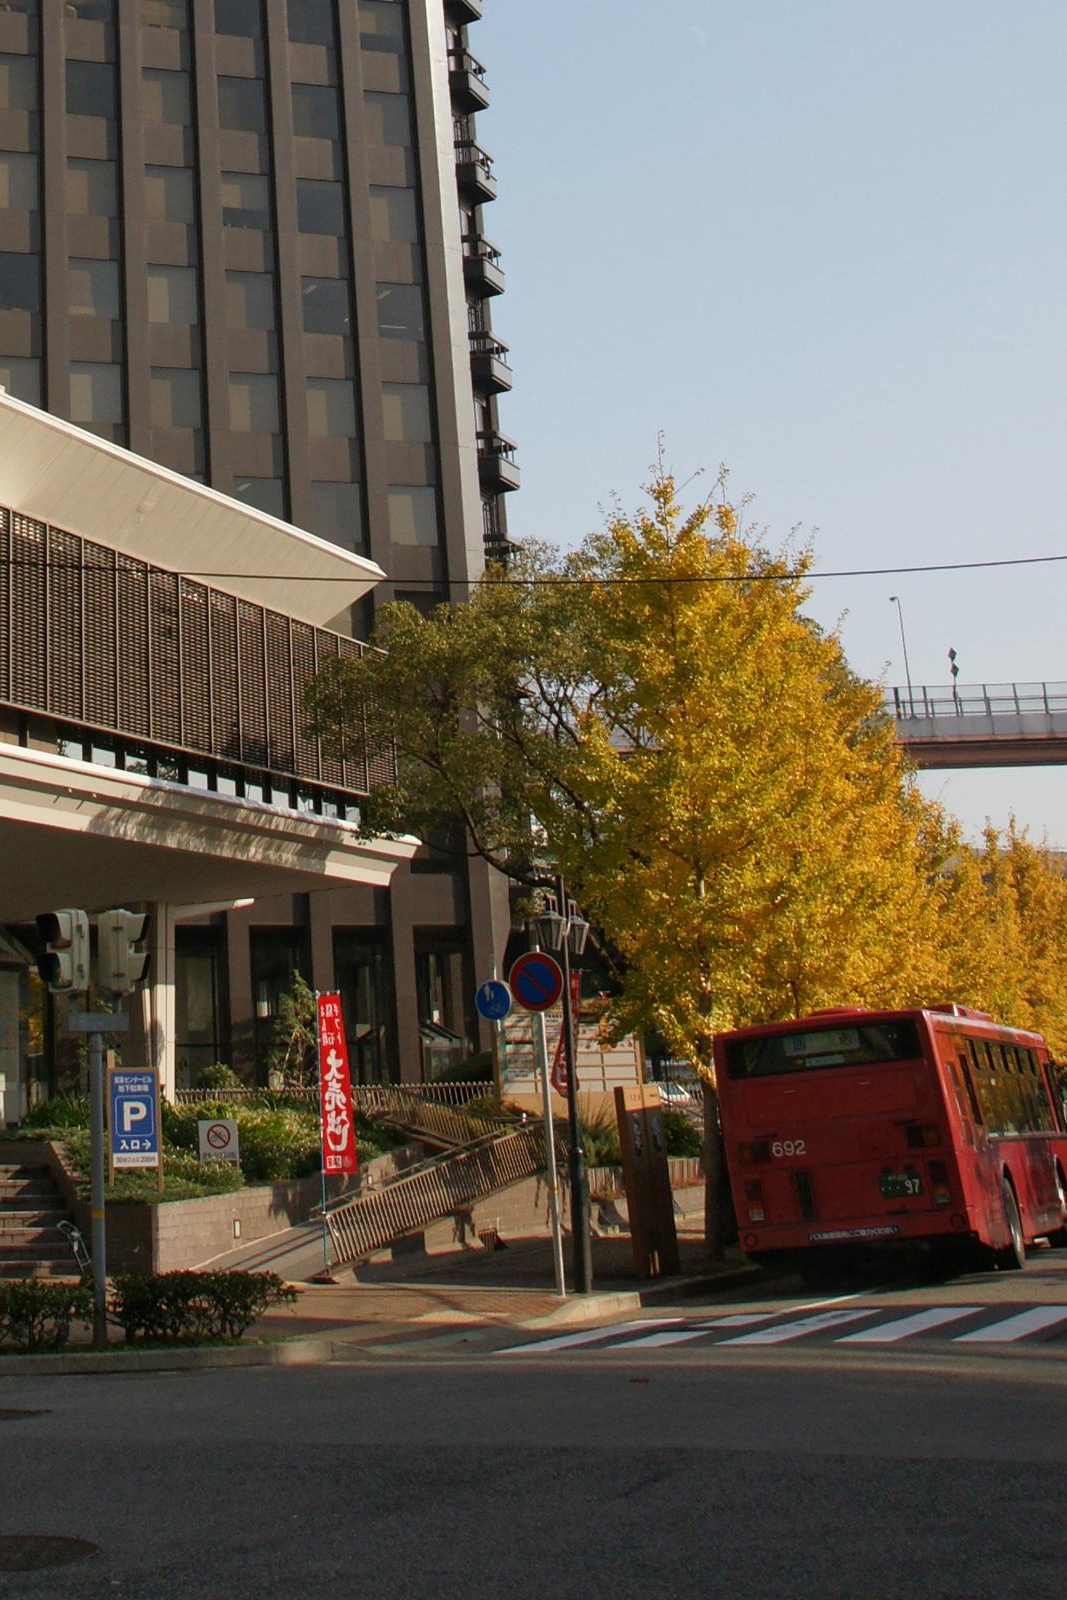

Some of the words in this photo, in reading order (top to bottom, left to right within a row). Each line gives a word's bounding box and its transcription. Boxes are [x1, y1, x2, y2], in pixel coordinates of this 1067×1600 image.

[123, 1101, 147, 1132] P
[120, 1139, 140, 1150] 入口
[772, 1140, 806, 1157] 692
